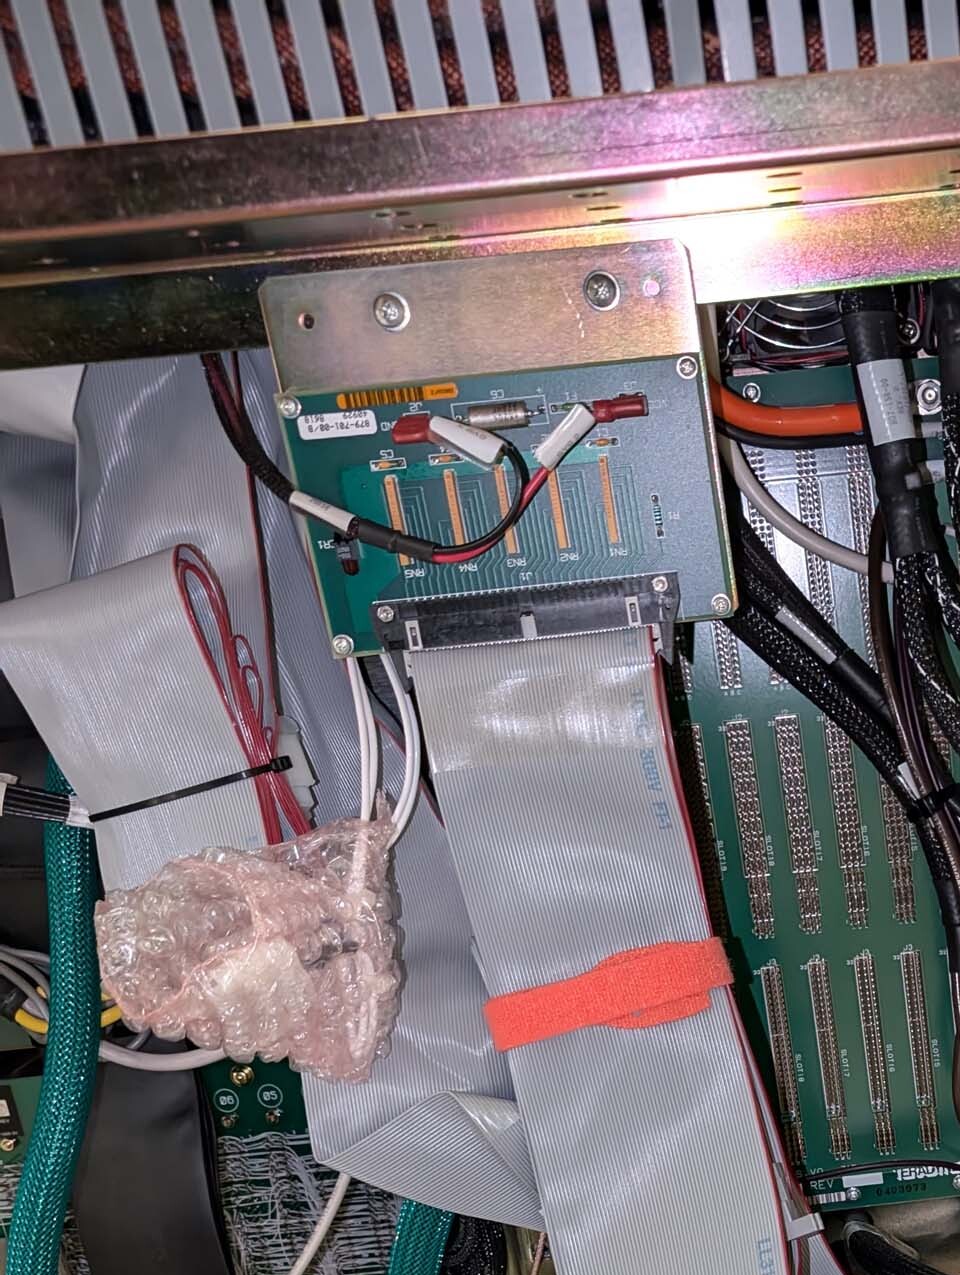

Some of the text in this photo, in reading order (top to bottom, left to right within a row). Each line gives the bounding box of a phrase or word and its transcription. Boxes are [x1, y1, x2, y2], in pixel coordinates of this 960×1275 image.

[409, 402, 423, 411] J2
[458, 563, 478, 573] RN4
[507, 558, 527, 567] RN3
[218, 1094, 234, 1106] 06
[262, 1090, 278, 1102] 05
[810, 1179, 835, 1191] REV
